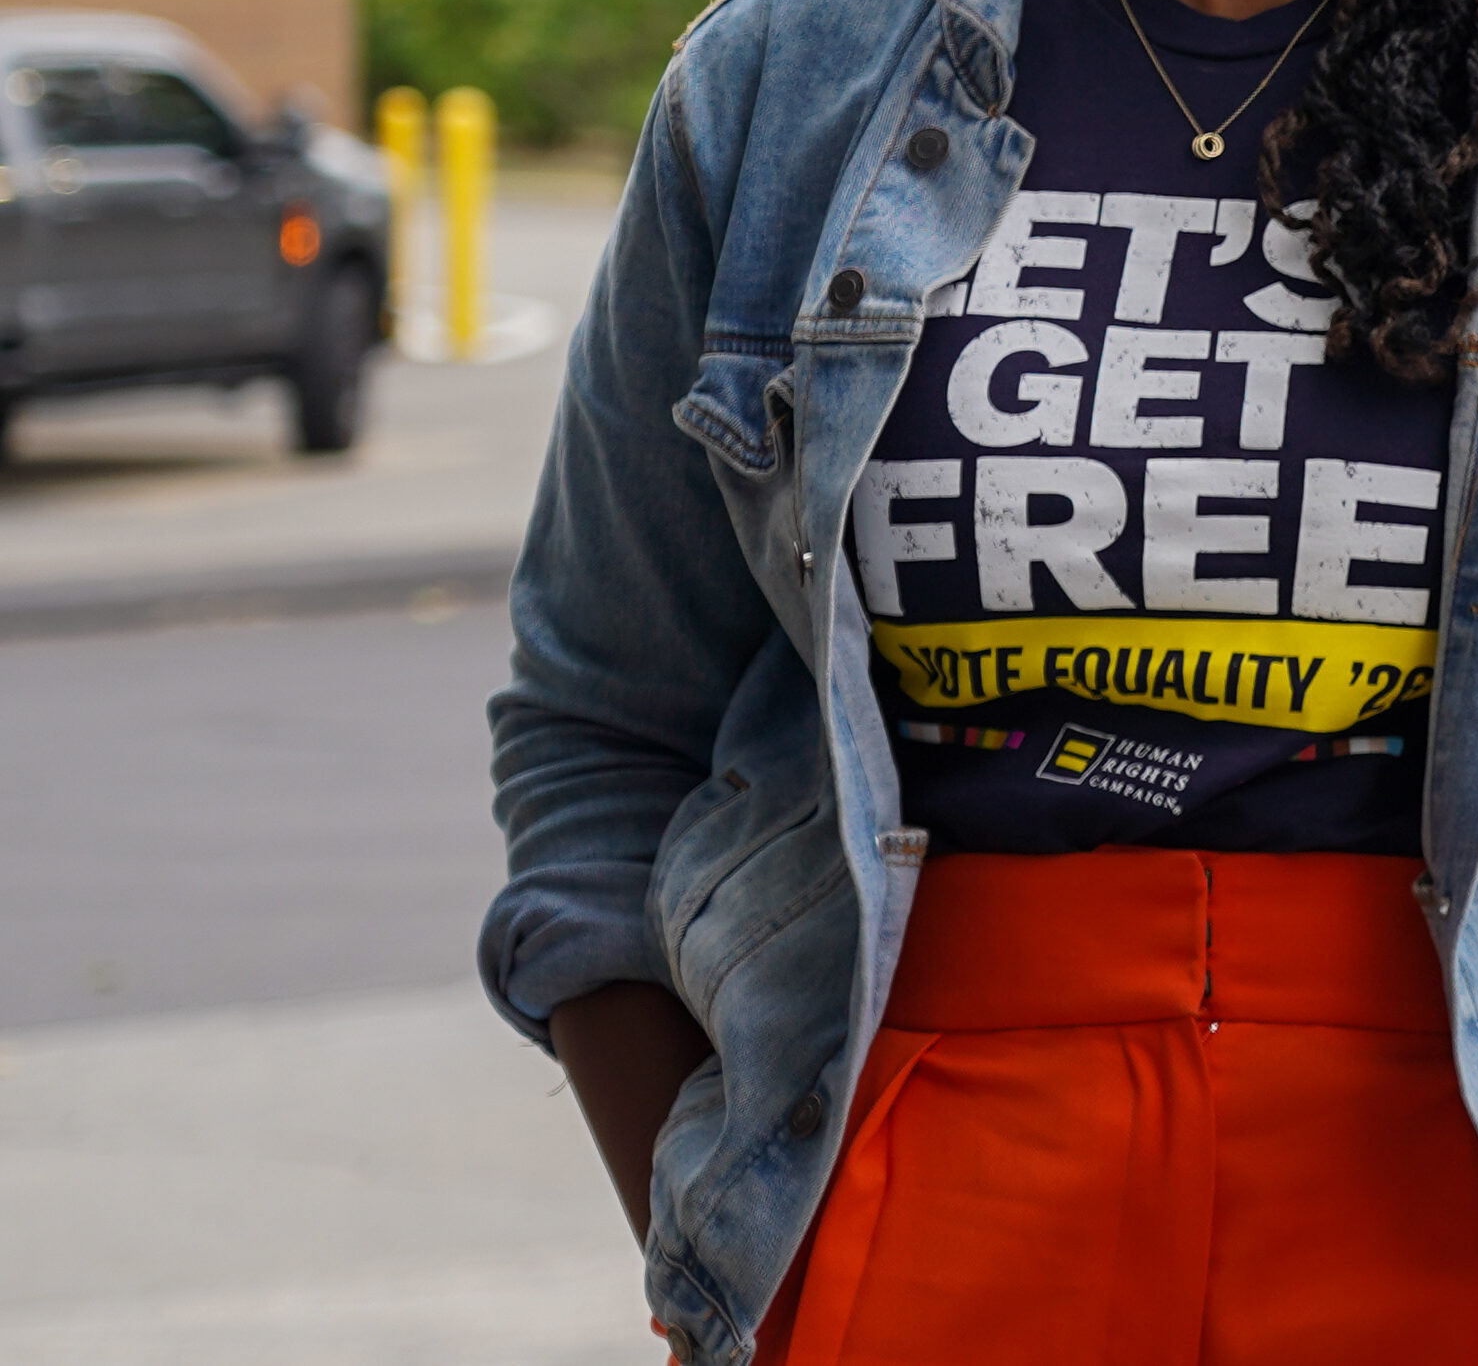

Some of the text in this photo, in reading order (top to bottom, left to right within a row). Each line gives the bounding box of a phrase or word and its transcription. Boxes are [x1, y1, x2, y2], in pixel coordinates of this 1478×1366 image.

[926, 190, 1344, 332] ET'S
[946, 319, 1327, 451] GET
[852, 455, 1442, 626] FREE
[899, 646, 1024, 699] VOTE
[1043, 646, 1326, 714] EQUALITY
[1101, 757, 1191, 792] RIGHTS
[1115, 738, 1204, 771] HUMAN
